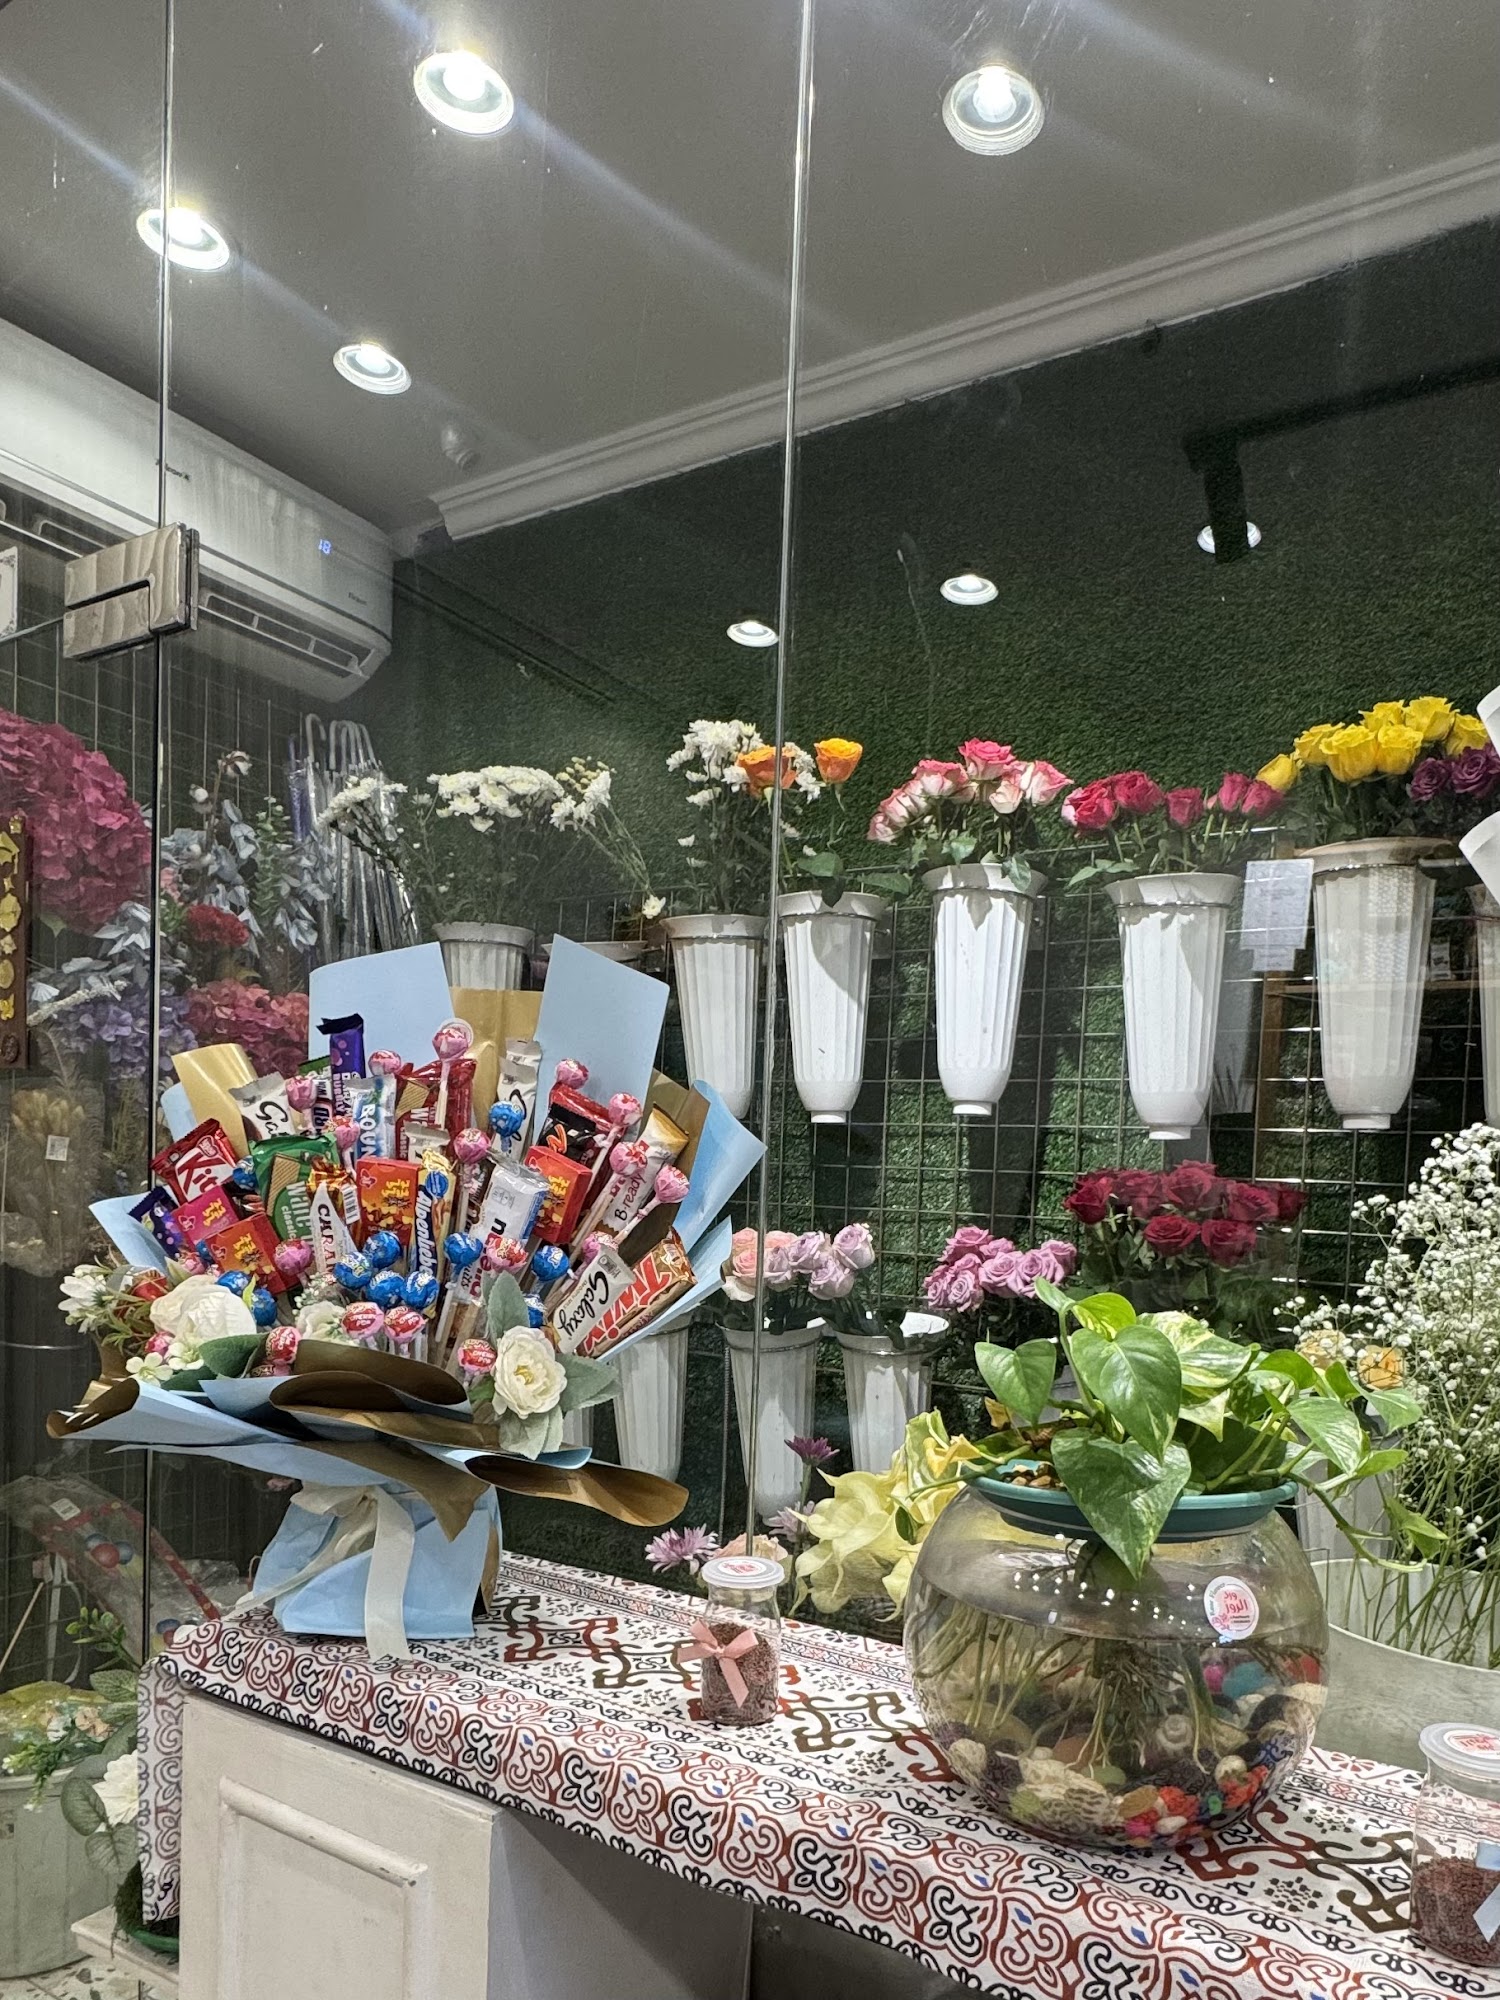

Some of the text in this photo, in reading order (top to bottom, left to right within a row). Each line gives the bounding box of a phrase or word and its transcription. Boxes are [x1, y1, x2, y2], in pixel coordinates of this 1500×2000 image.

[319, 539, 332, 555] 18
[614, 1173, 648, 1222] B-ready
[557, 1270, 610, 1337] Galaxy
